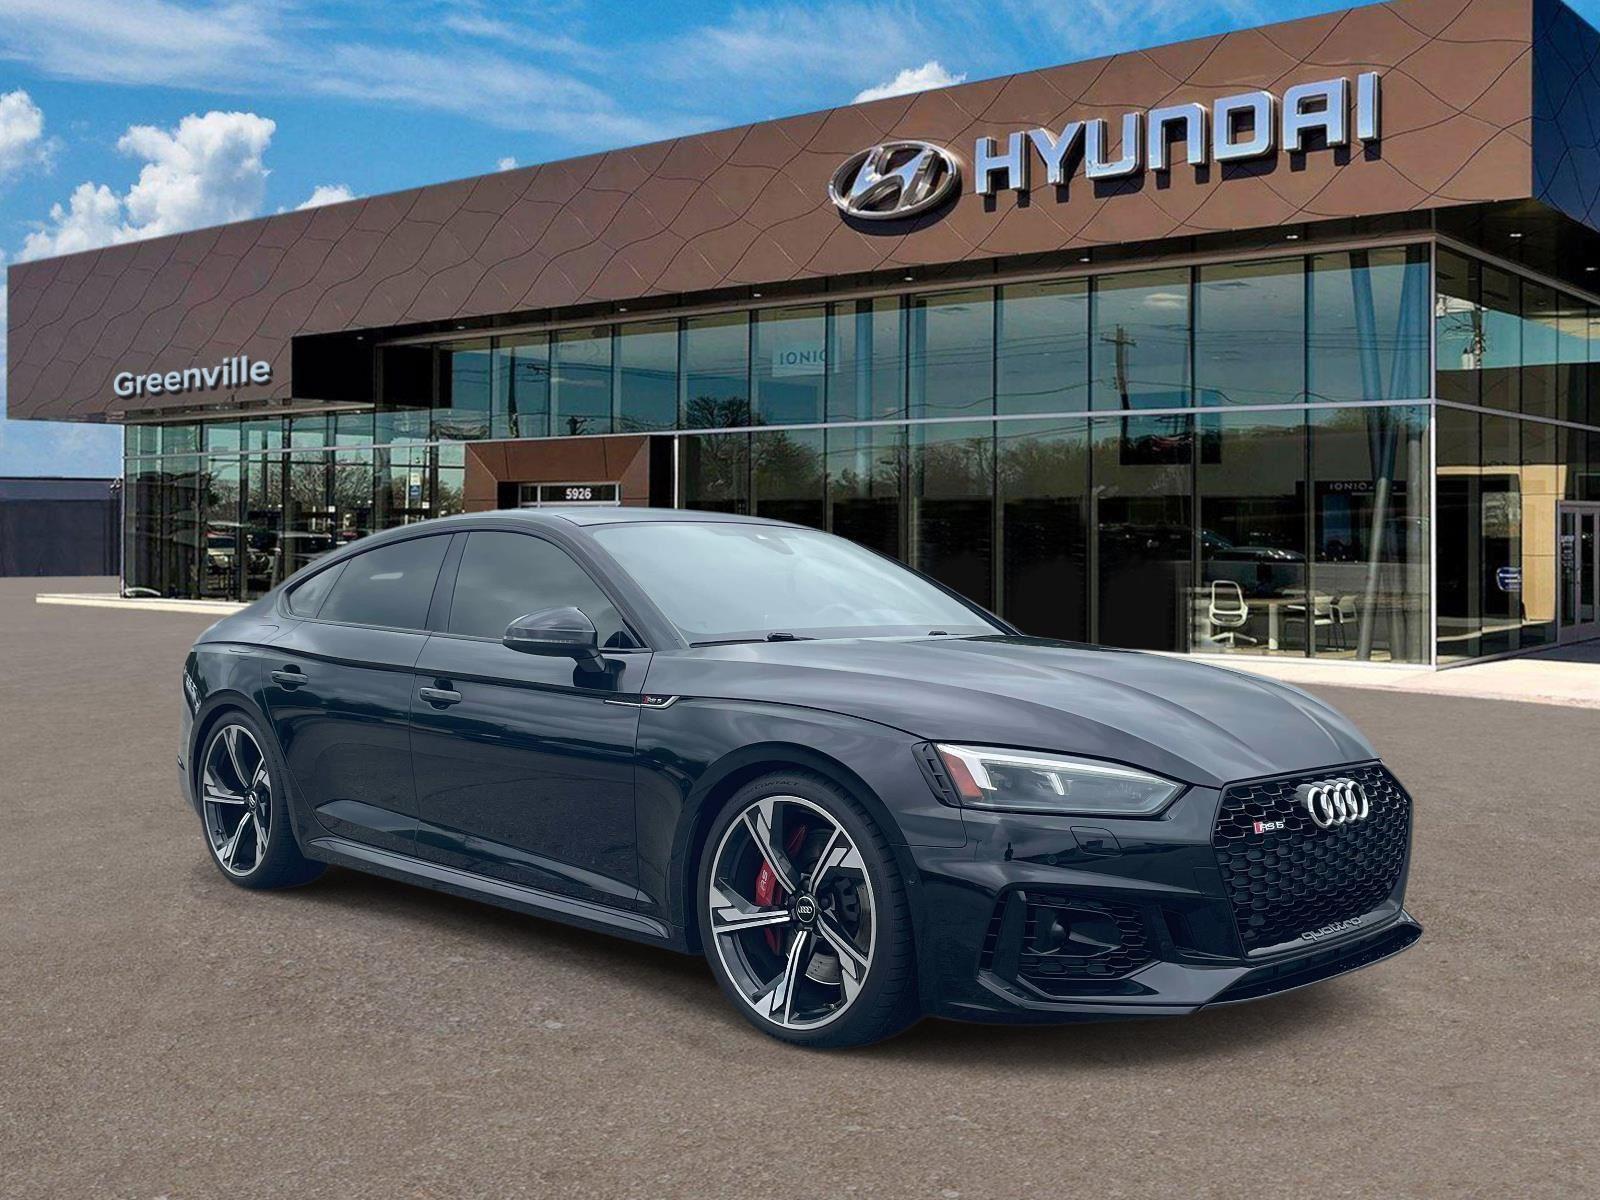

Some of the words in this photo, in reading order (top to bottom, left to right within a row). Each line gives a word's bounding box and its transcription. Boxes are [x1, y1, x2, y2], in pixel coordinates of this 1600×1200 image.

[975, 72, 1379, 196] HYUNDAI
[113, 355, 271, 397] Greenville
[565, 488, 592, 500] 5926
[760, 870, 769, 891] RS
[1301, 916, 1362, 941] quattro
